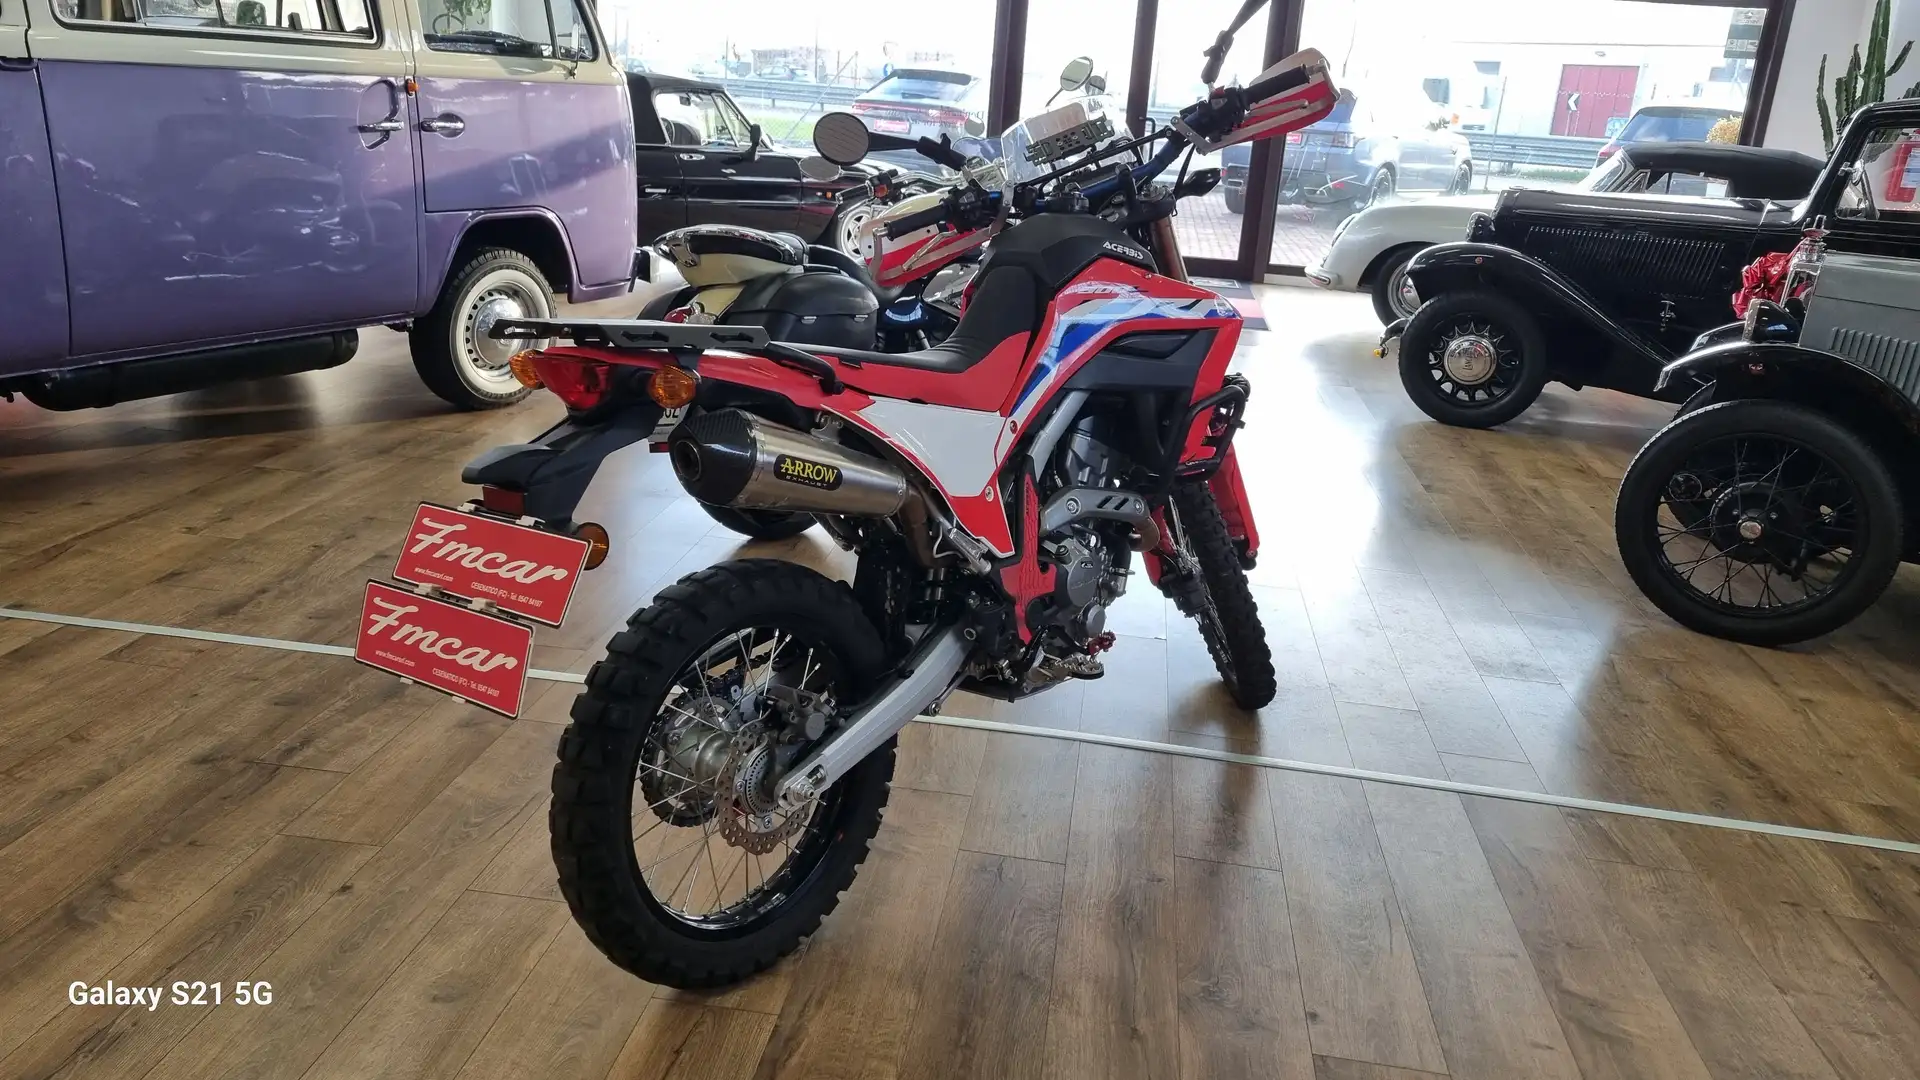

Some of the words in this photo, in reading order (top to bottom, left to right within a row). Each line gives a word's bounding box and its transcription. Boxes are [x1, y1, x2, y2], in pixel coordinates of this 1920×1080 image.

[780, 457, 838, 483] ARROW
[786, 475, 828, 487] EXHAUST
[410, 517, 568, 584] Fmcar
[367, 597, 518, 672] Fmcar
